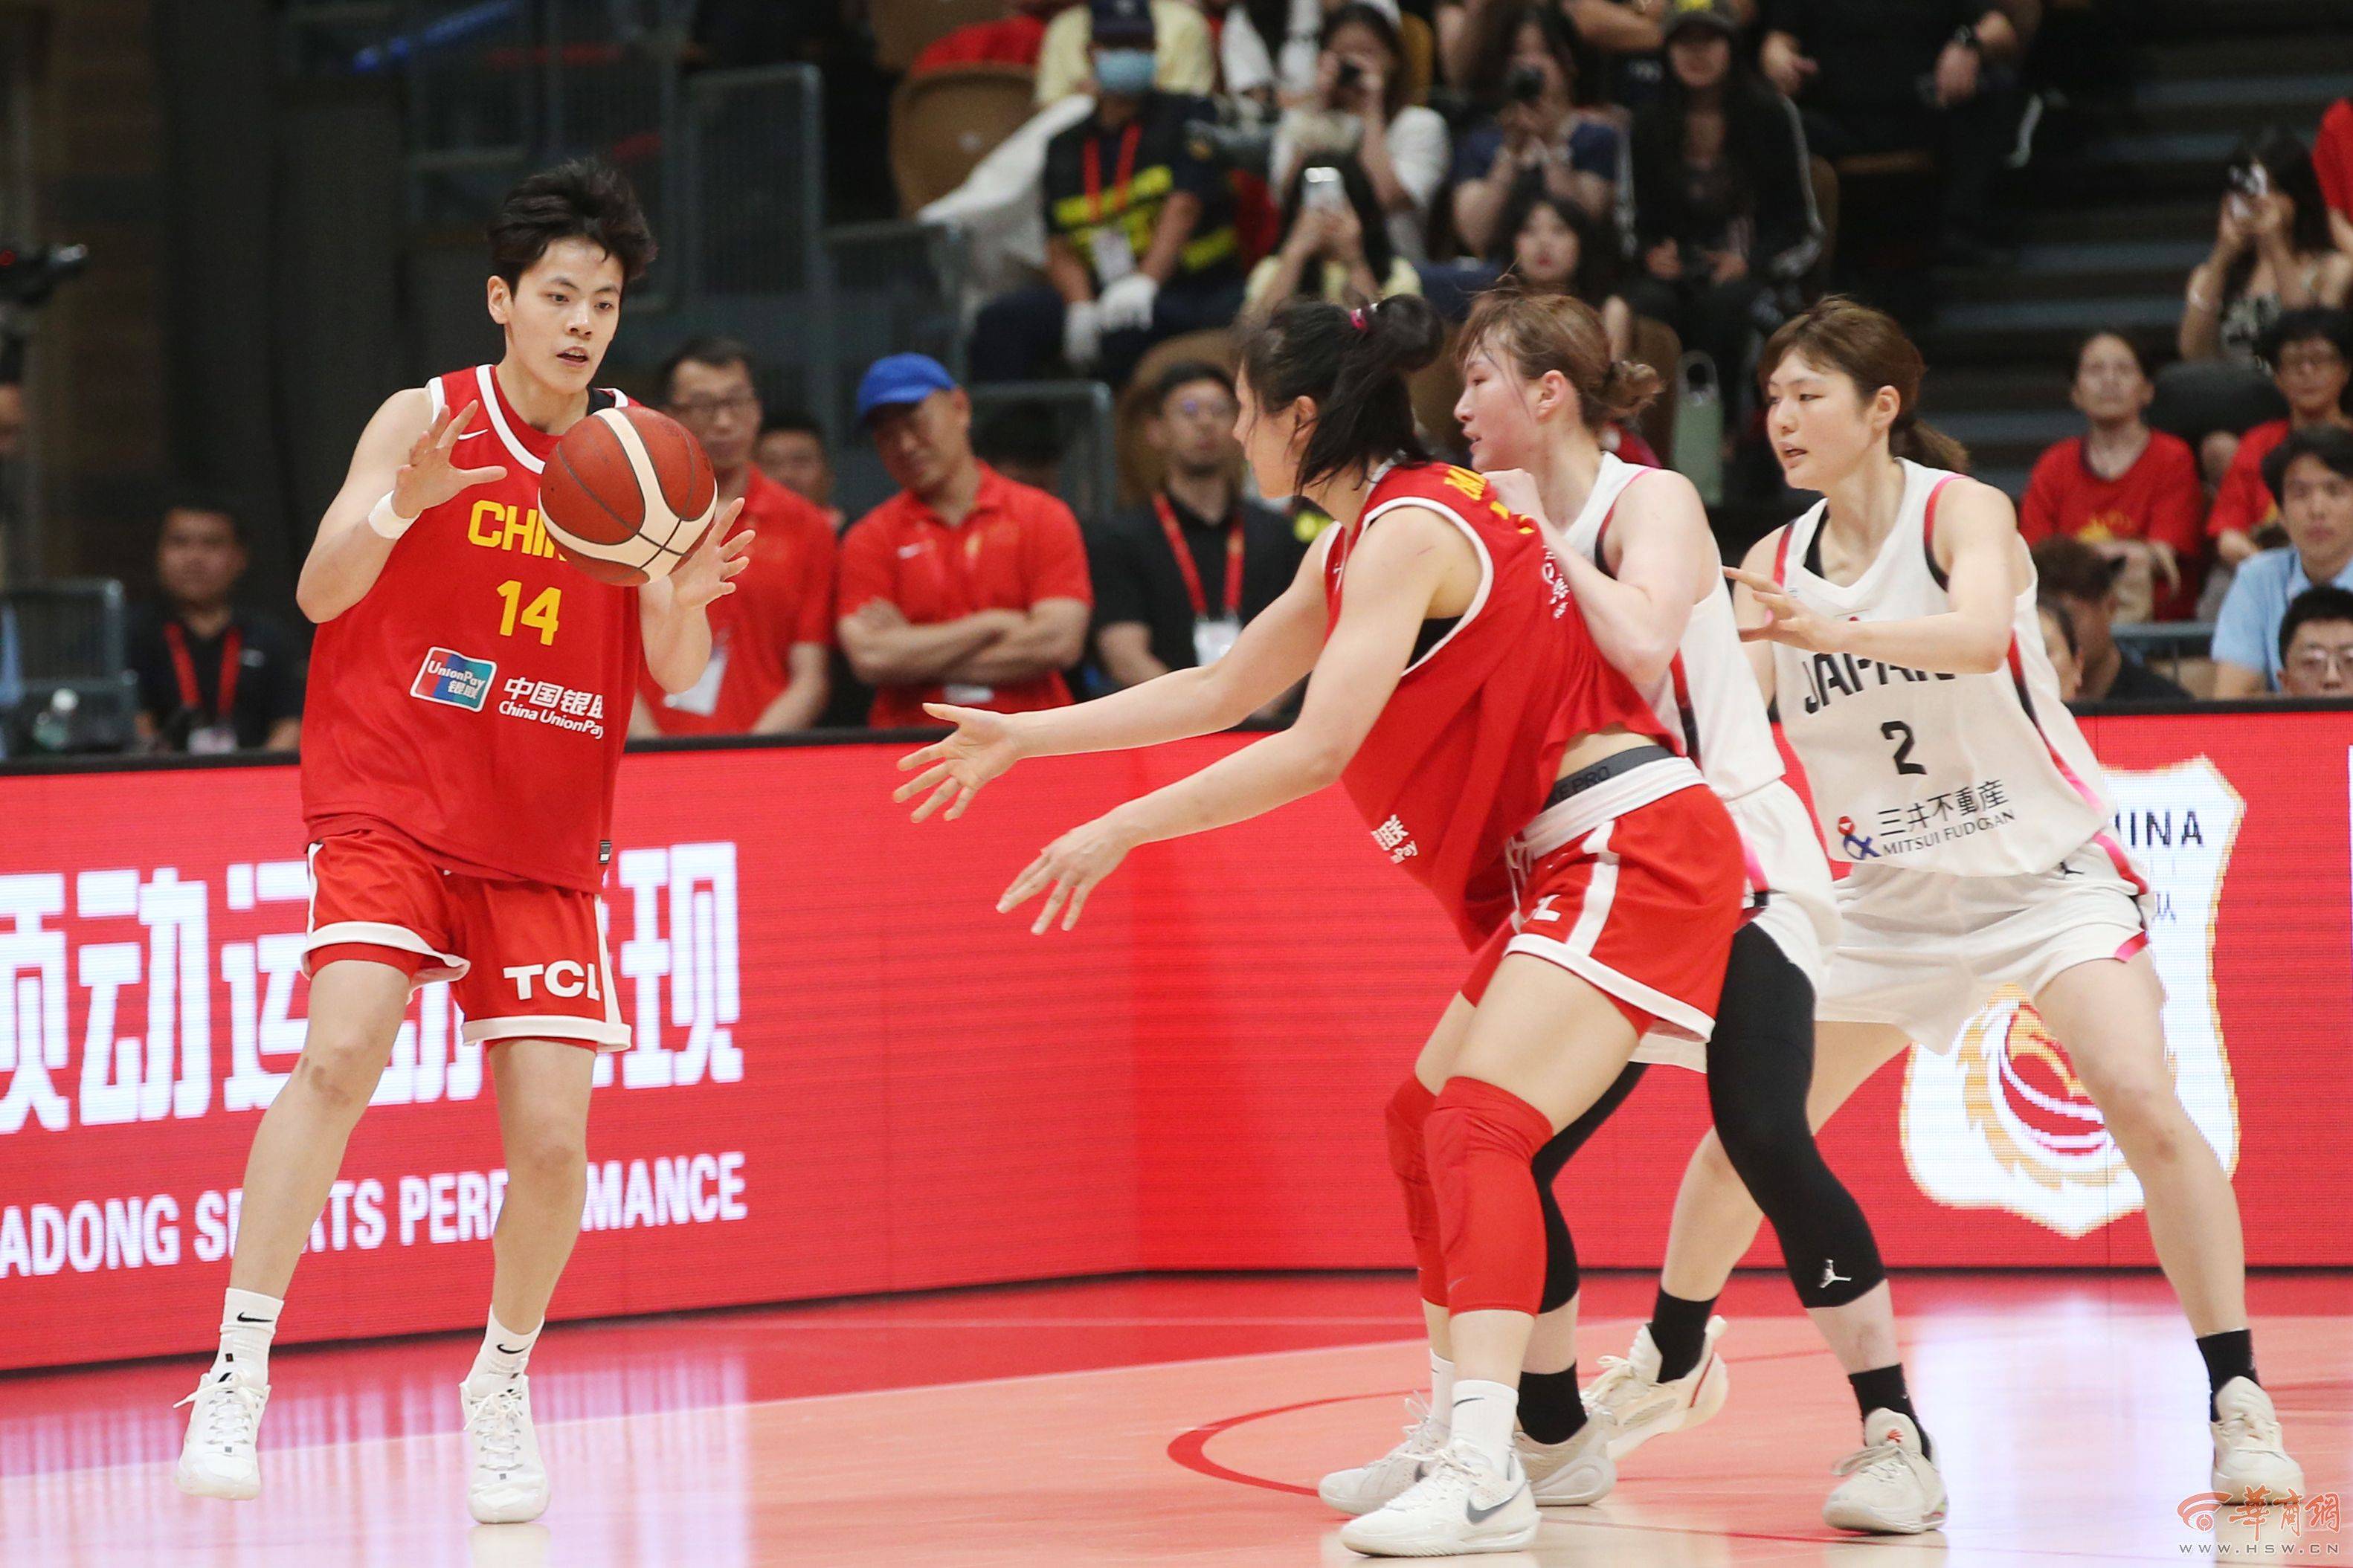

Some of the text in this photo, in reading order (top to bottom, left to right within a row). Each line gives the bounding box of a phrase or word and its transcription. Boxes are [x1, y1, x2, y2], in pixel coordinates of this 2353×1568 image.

[468, 500, 567, 561] CHI
[496, 580, 561, 646] 14
[428, 660, 486, 690] UnionPay
[499, 700, 538, 720] China
[1880, 720, 1927, 775] 2
[1883, 832, 1940, 855] MITSUI
[2115, 810, 2204, 846] INA
[503, 960, 600, 1001] TCL
[0, 1151, 747, 1278] ADONG STS PERFMANCE
